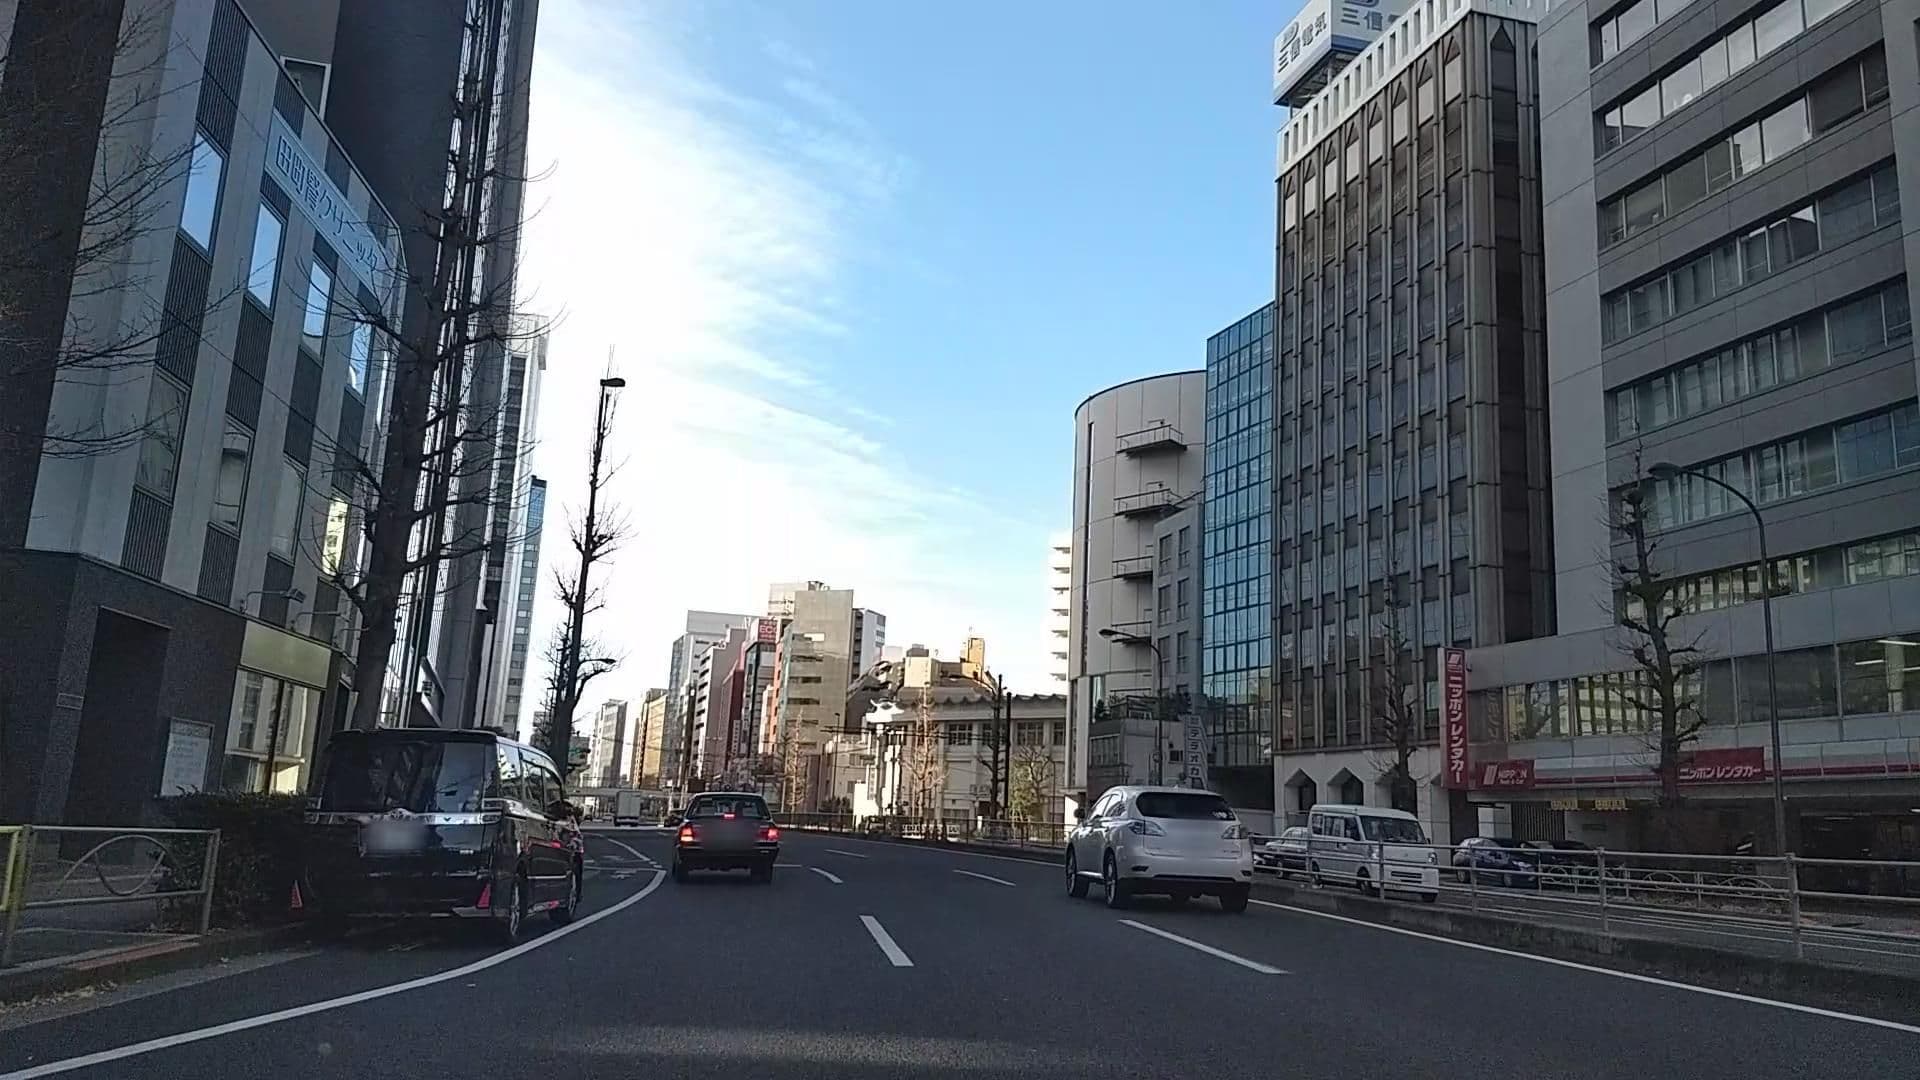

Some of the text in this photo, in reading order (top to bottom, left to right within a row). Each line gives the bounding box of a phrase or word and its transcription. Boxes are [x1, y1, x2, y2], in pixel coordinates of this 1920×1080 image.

[1448, 675, 1465, 784] ニッポンレンタカー
[1679, 765, 1762, 781] ニッポンレンタカー
